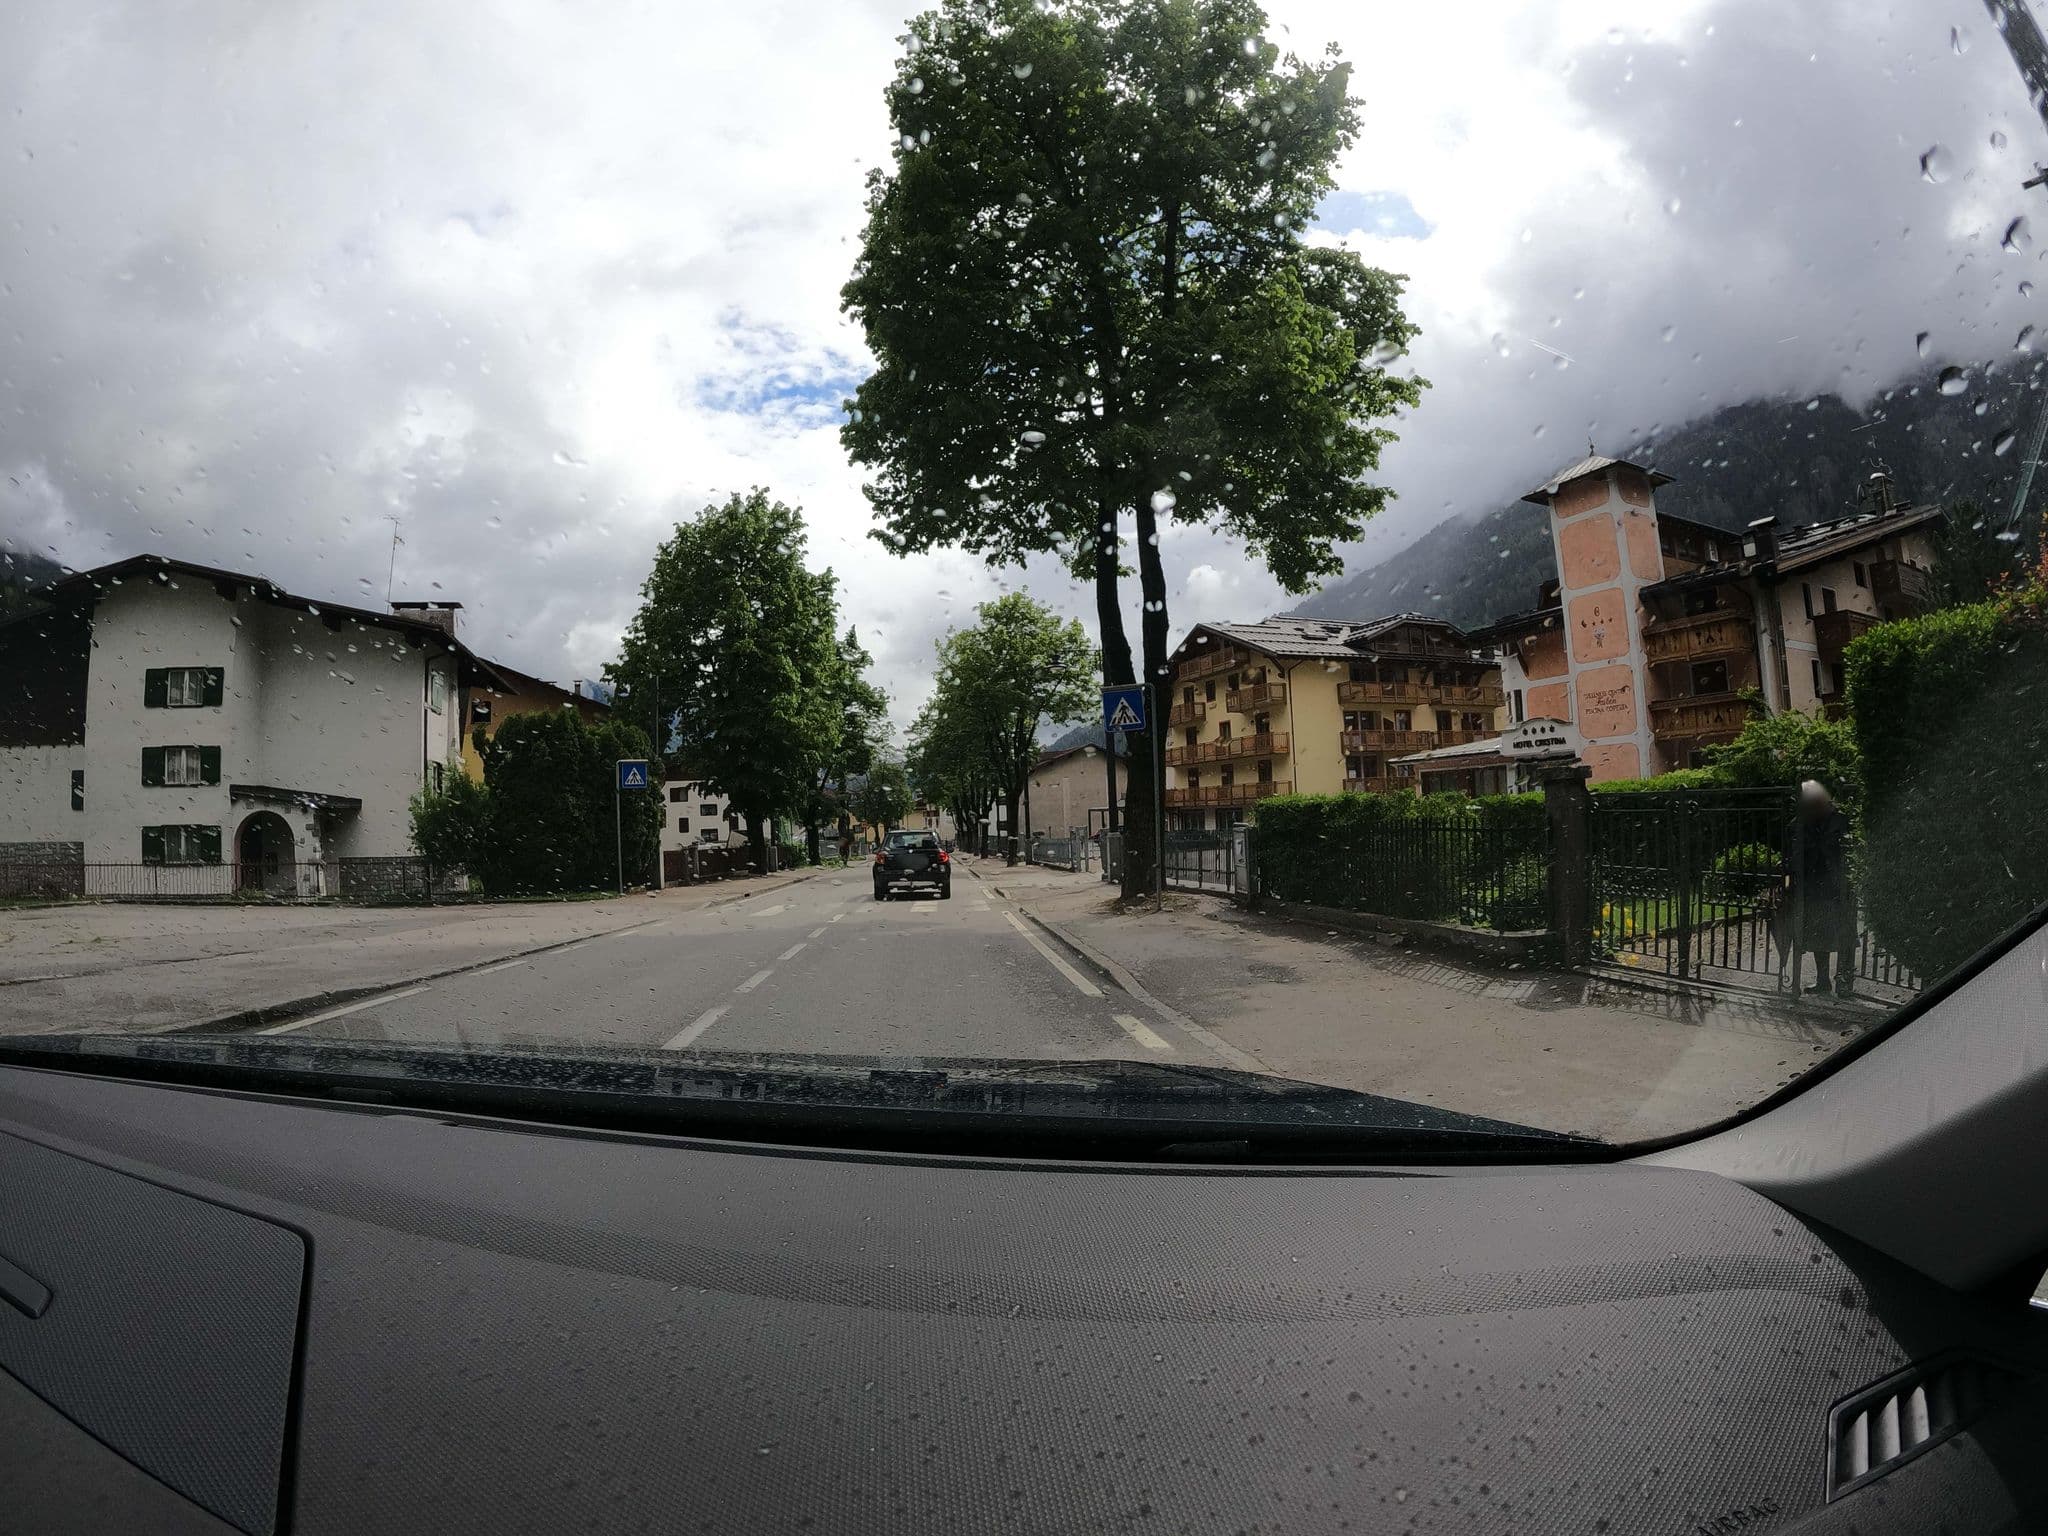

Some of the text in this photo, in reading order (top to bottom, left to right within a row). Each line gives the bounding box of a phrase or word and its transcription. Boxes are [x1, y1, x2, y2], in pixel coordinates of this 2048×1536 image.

[1513, 737, 1567, 749] HOTEL CRISTINA
[1697, 1497, 1780, 1536] AIRBAG
